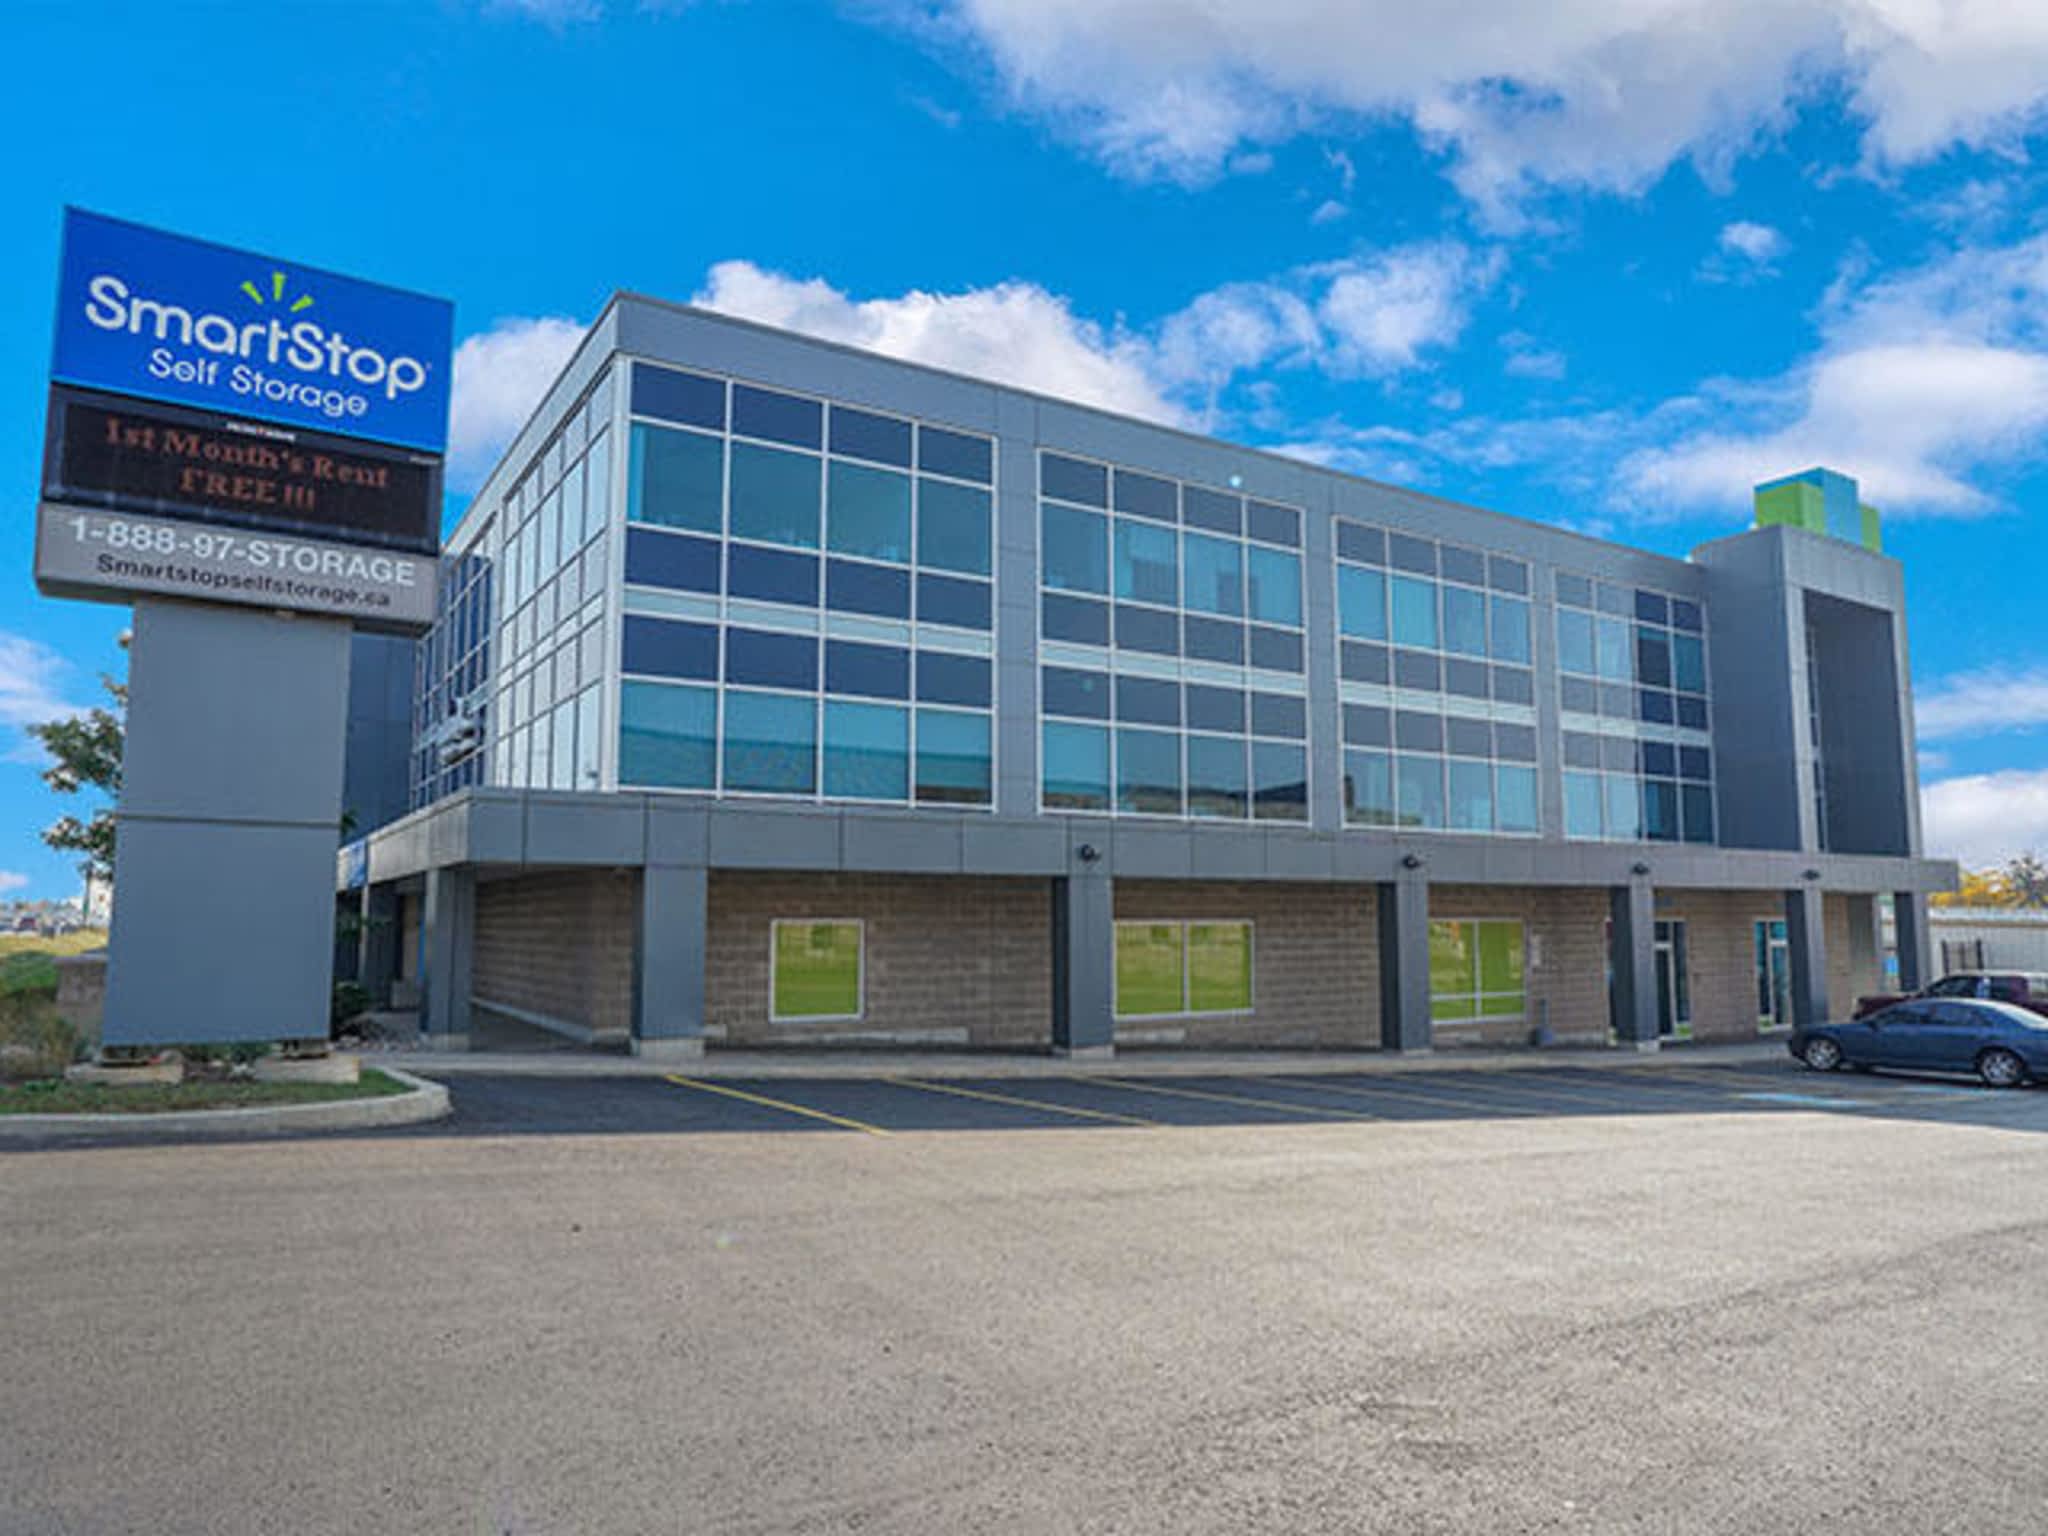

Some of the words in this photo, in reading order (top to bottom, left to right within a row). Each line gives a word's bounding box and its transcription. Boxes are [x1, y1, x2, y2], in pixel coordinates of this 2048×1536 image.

[85, 275, 426, 399] SmartStop
[148, 347, 219, 387] Self
[229, 364, 369, 418] Storage
[105, 416, 156, 450] 1st
[161, 428, 304, 473] Month's
[313, 454, 390, 488] Rent
[178, 466, 277, 504] FREE
[68, 514, 416, 587] 1-888-97-STORAGE
[96, 552, 392, 607] Smartstopselfstorage.ca
